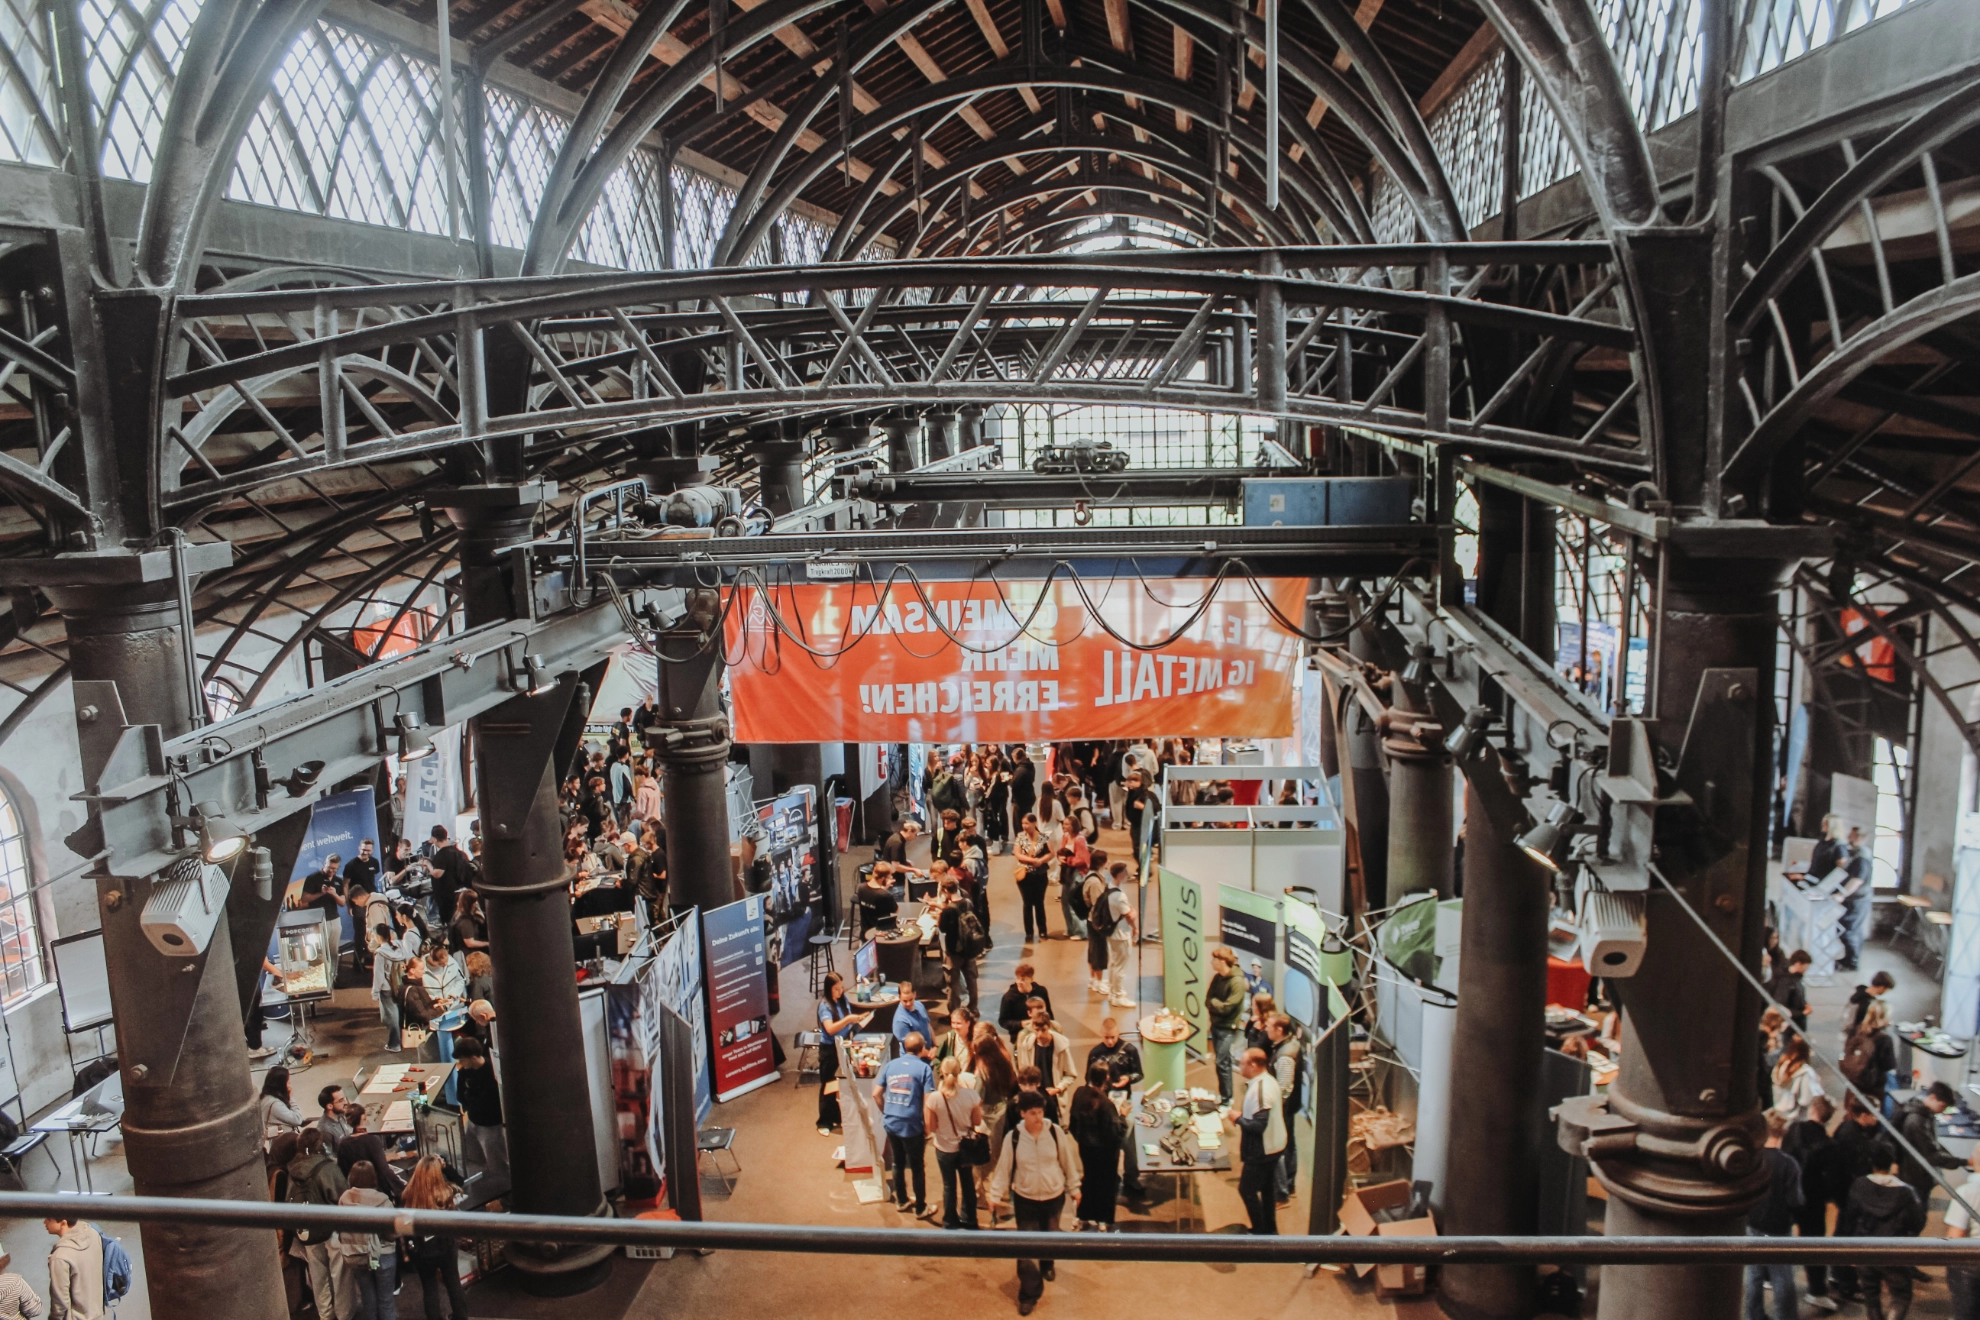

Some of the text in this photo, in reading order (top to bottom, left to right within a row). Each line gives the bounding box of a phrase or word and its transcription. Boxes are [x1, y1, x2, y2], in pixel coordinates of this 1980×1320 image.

[834, 567, 848, 575] 2000
[419, 751, 439, 813] EATON
[316, 830, 354, 847] weltweit.
[711, 934, 728, 947] Deine
[728, 927, 750, 942] Zukunft
[1177, 886, 1202, 1056] Novelis
